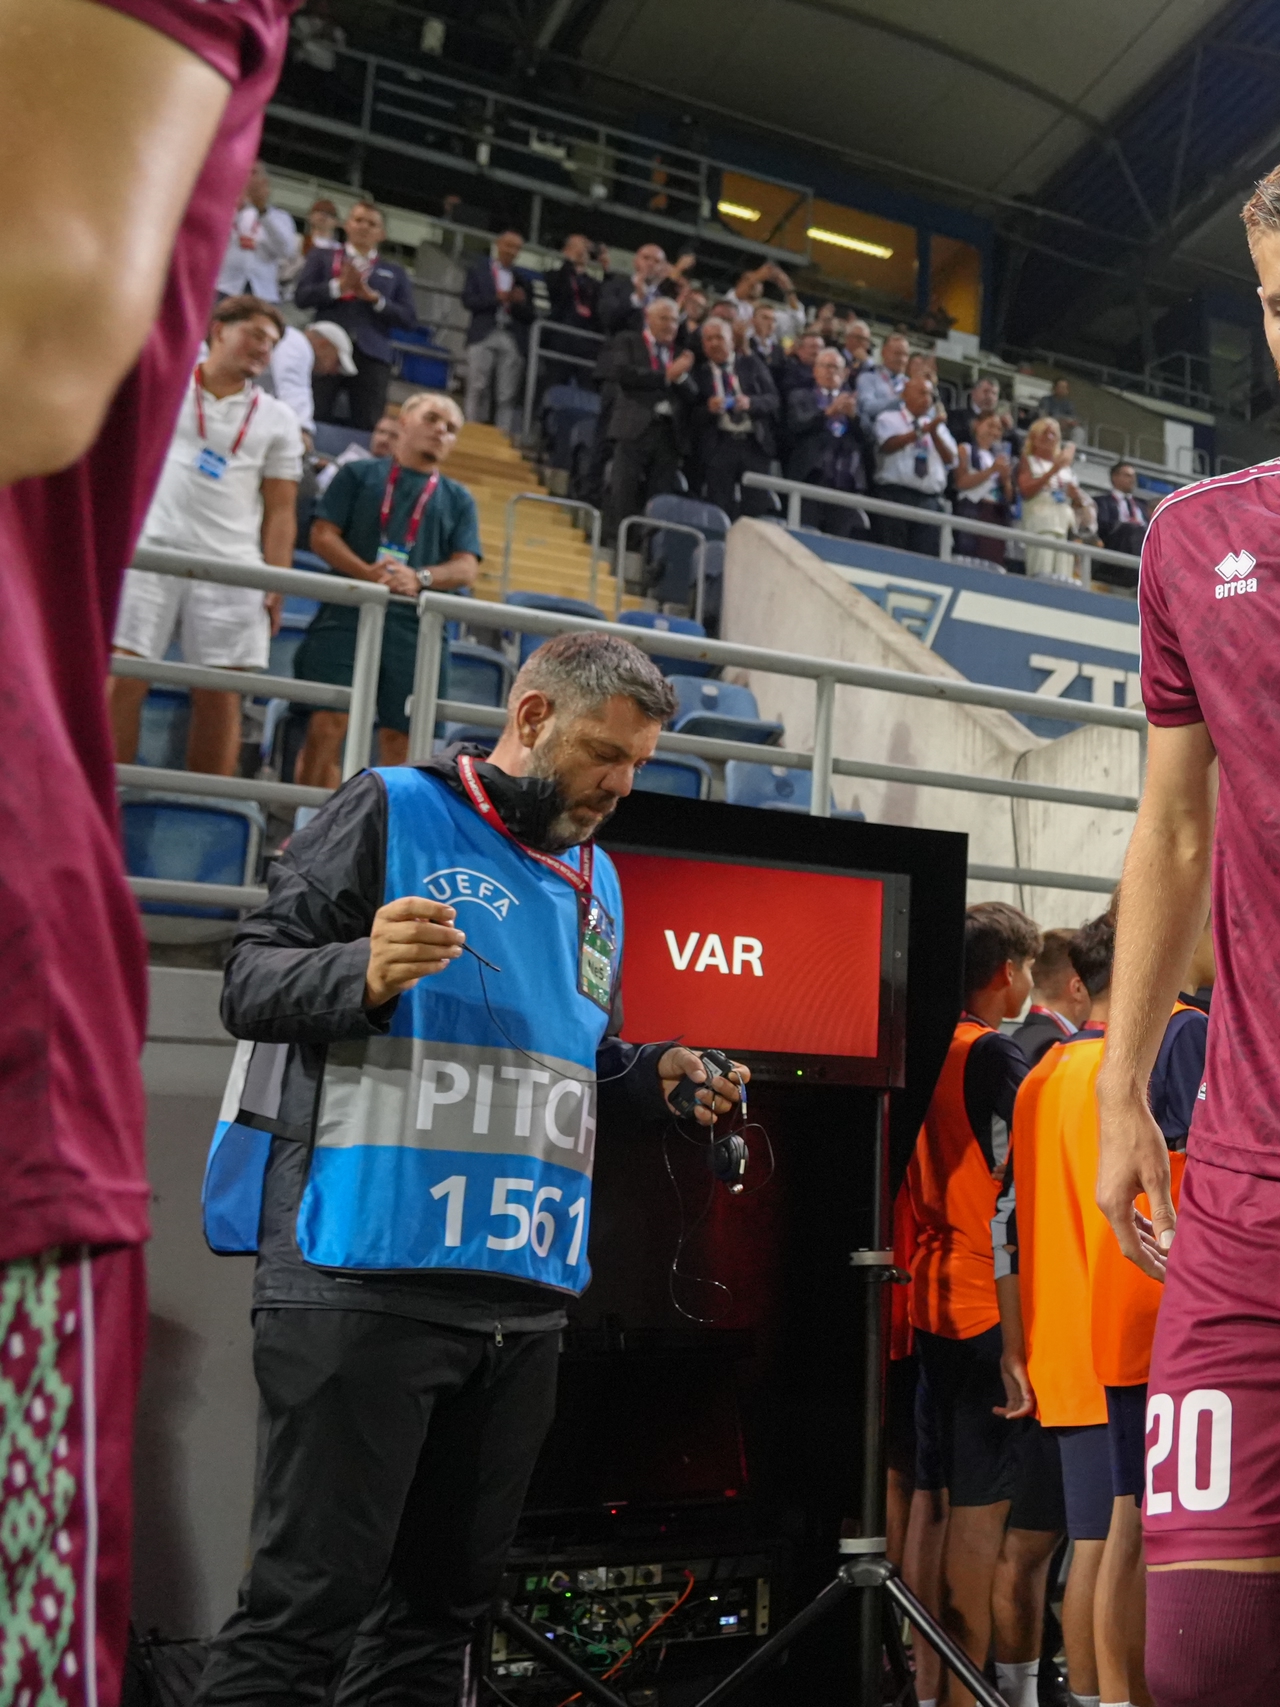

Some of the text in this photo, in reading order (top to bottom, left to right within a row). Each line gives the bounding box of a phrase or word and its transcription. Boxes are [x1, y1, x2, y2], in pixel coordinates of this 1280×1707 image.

[1215, 578, 1257, 599] errea
[1029, 653, 1141, 709] ZT
[428, 874, 510, 917] UEFA
[664, 929, 764, 977] VAR
[416, 1059, 596, 1161] PITCH
[1145, 1388, 1233, 1516] 20
